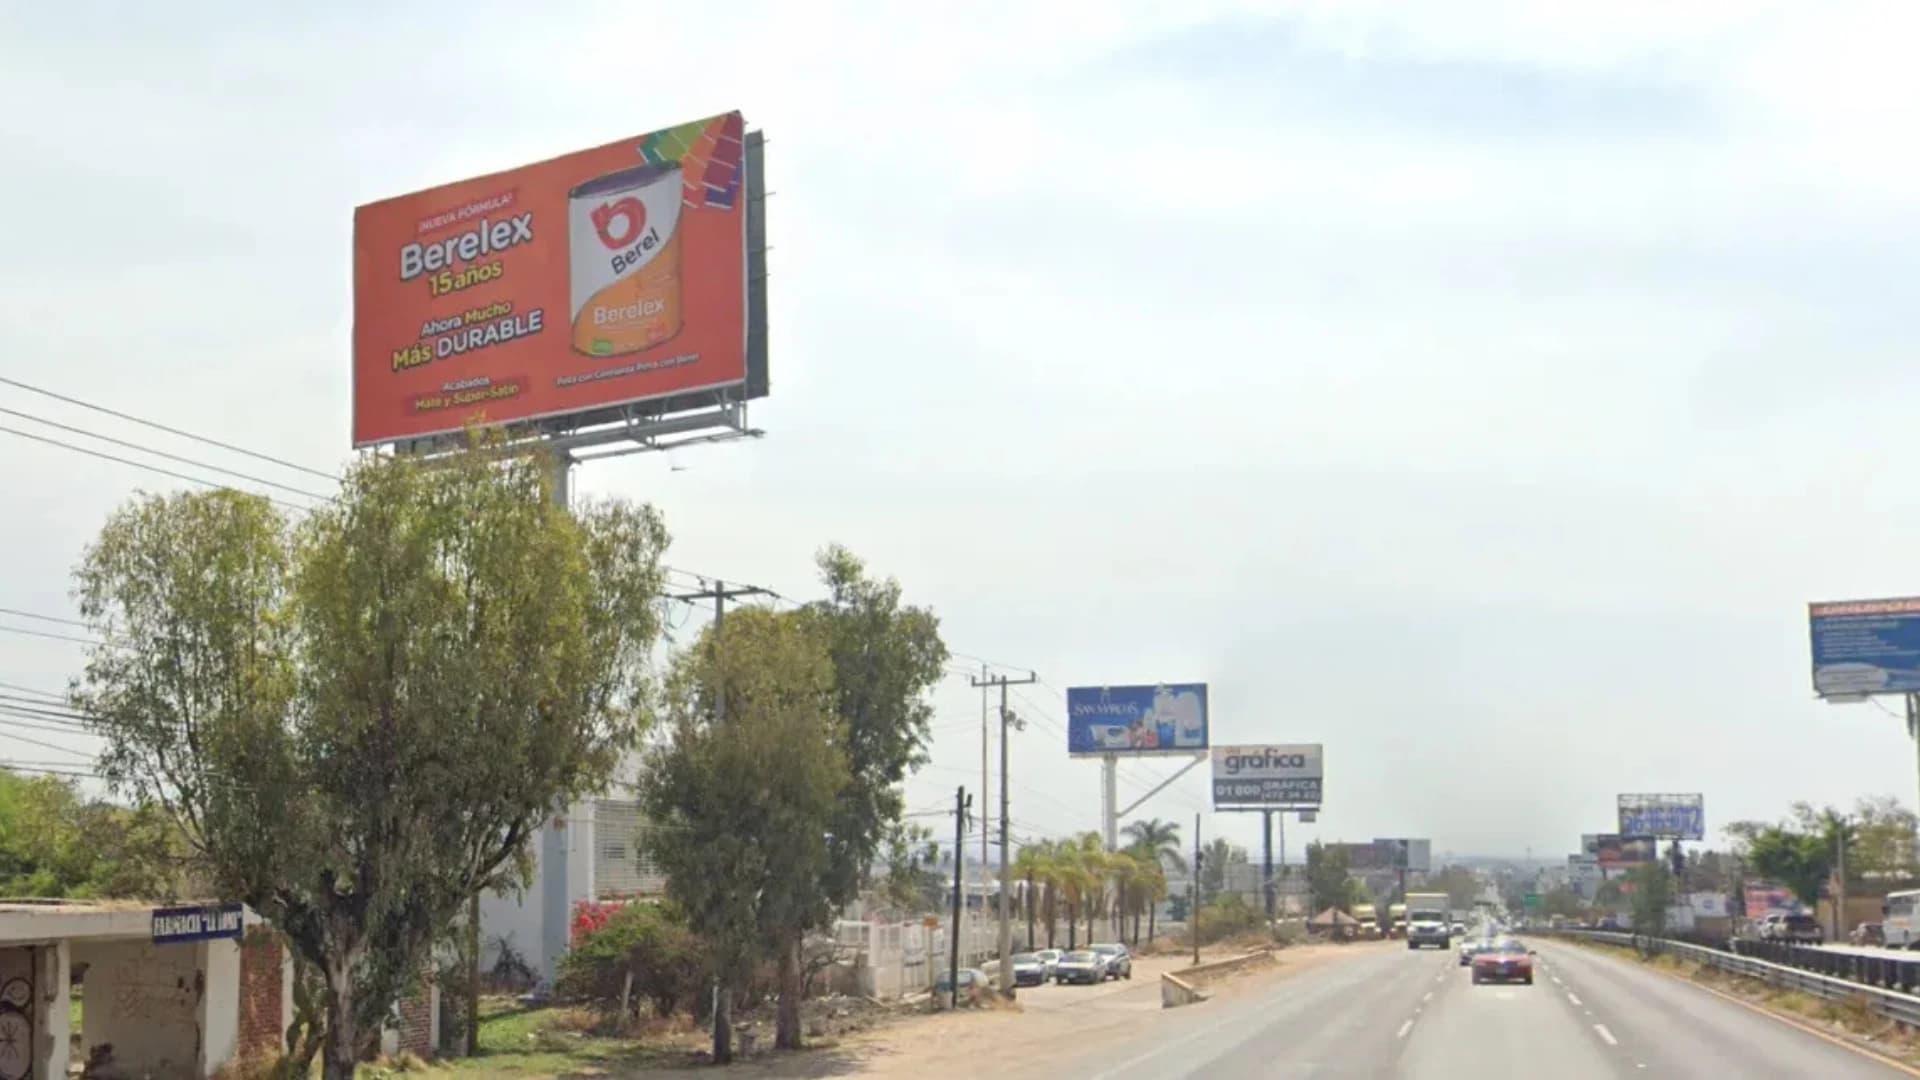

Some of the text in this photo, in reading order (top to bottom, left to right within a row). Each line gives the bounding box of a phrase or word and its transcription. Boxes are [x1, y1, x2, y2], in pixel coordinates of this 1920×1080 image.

[399, 212, 533, 280] Berelex
[610, 226, 660, 275] Berel
[421, 303, 512, 337] Ahora Mucho
[593, 298, 665, 324] Berelex
[392, 310, 543, 370] Más DURABLE
